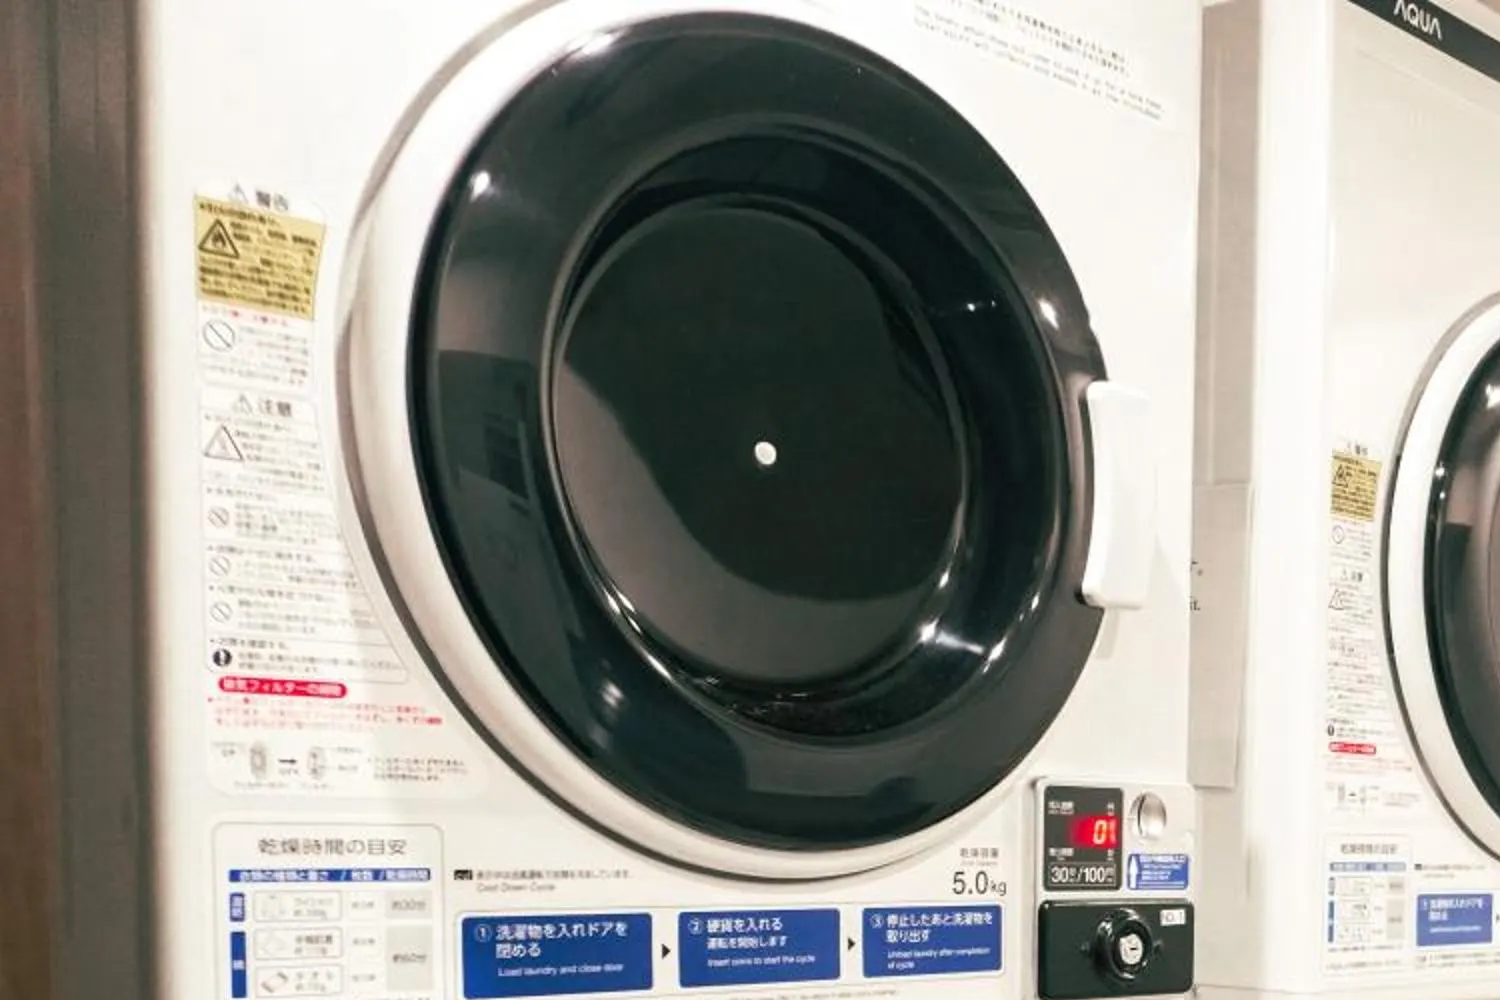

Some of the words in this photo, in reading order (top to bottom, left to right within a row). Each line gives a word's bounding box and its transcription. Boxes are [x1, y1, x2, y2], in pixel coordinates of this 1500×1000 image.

[1394, 0, 1442, 40] AQUA
[257, 838, 408, 856] 乾燥時間の目安
[496, 921, 629, 941] 洗濯物を入れドアを
[496, 943, 542, 959] 閉める
